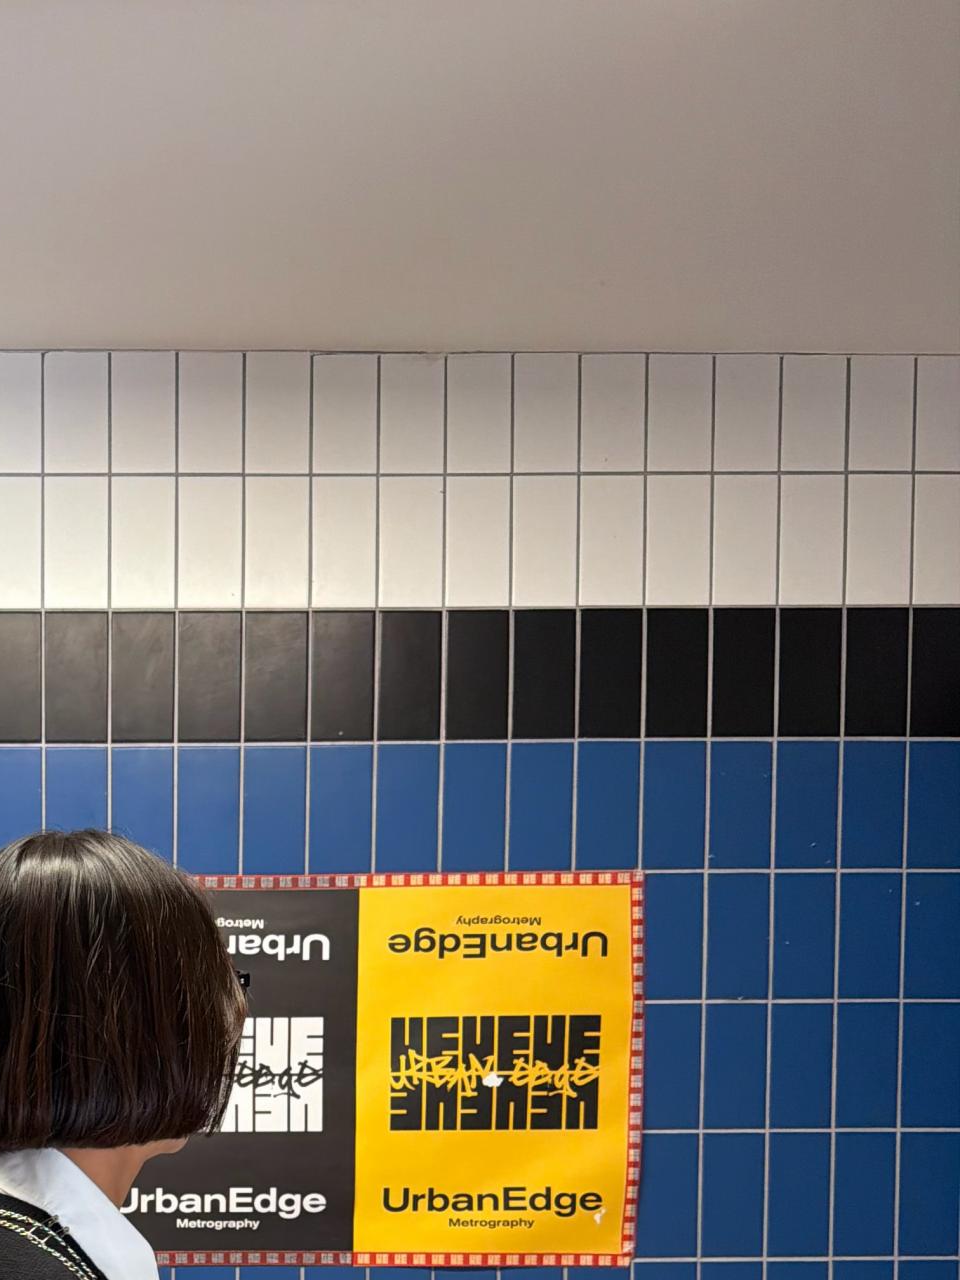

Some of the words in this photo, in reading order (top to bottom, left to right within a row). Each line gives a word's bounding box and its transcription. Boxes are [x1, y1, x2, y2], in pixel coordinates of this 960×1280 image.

[216, 917, 264, 929] Metrog
[456, 915, 542, 926] Metrography
[388, 927, 608, 959] UrbanEdge
[383, 1187, 603, 1217] UrbanEdge
[176, 1218, 260, 1230] Metrography
[448, 1217, 535, 1229] Metrography
